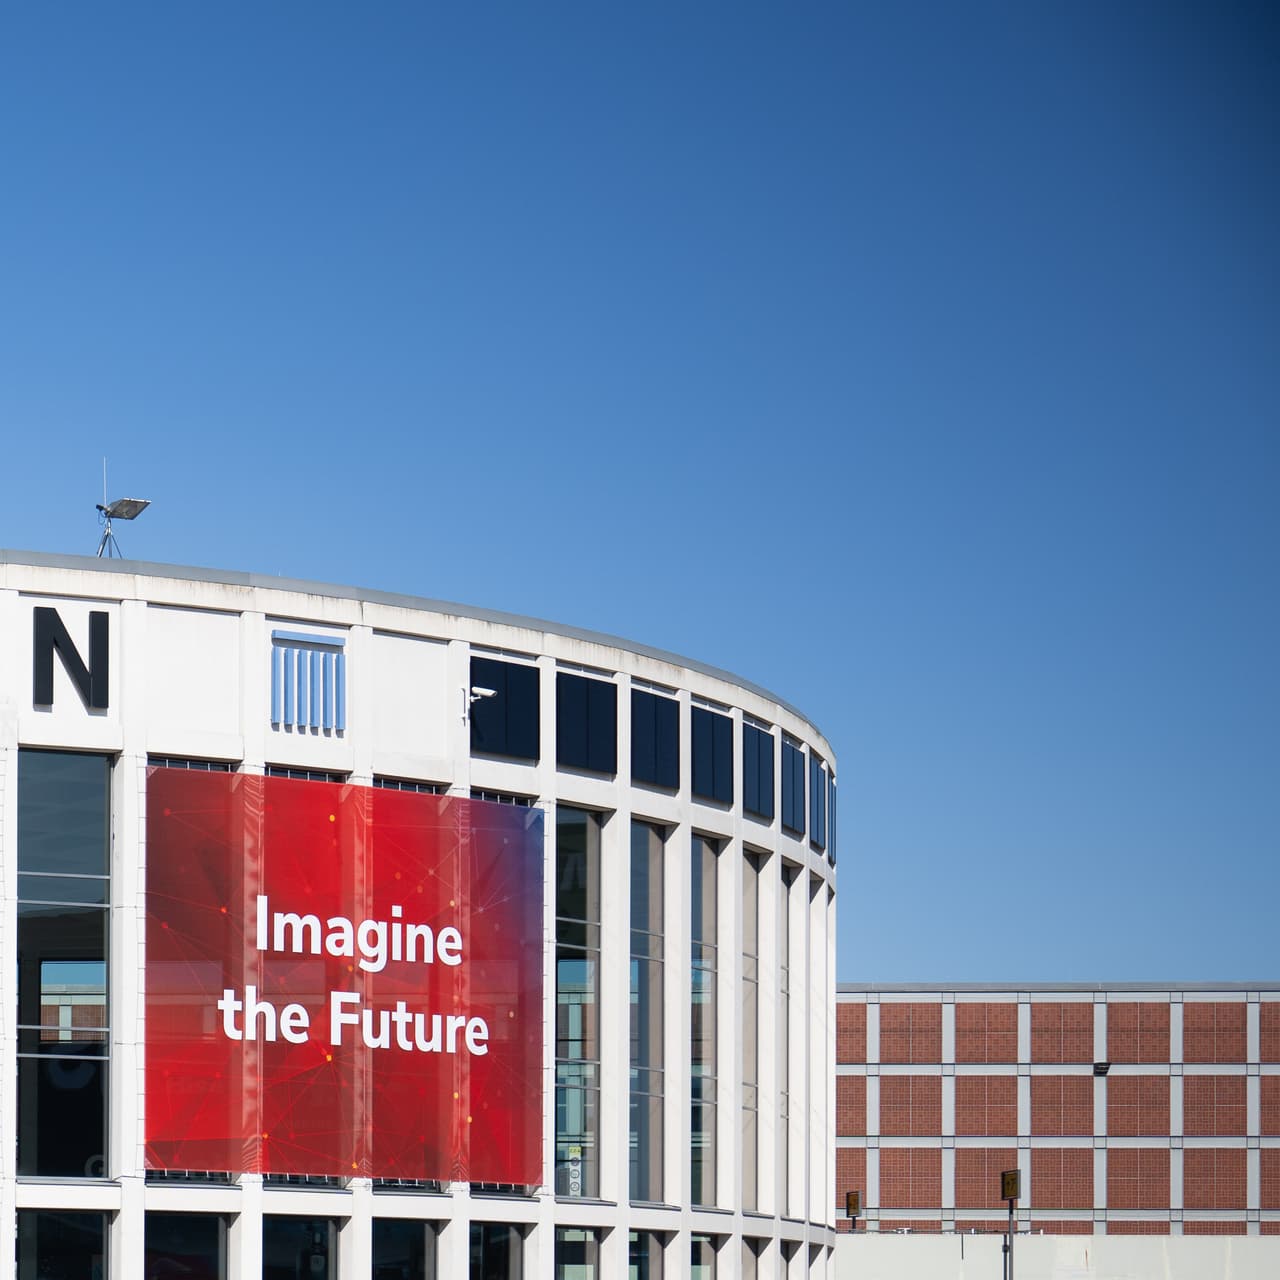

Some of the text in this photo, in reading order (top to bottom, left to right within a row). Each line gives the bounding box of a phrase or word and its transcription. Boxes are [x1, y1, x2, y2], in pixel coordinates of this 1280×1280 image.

[256, 895, 463, 972] Imagine
[217, 985, 489, 1056] the Future
